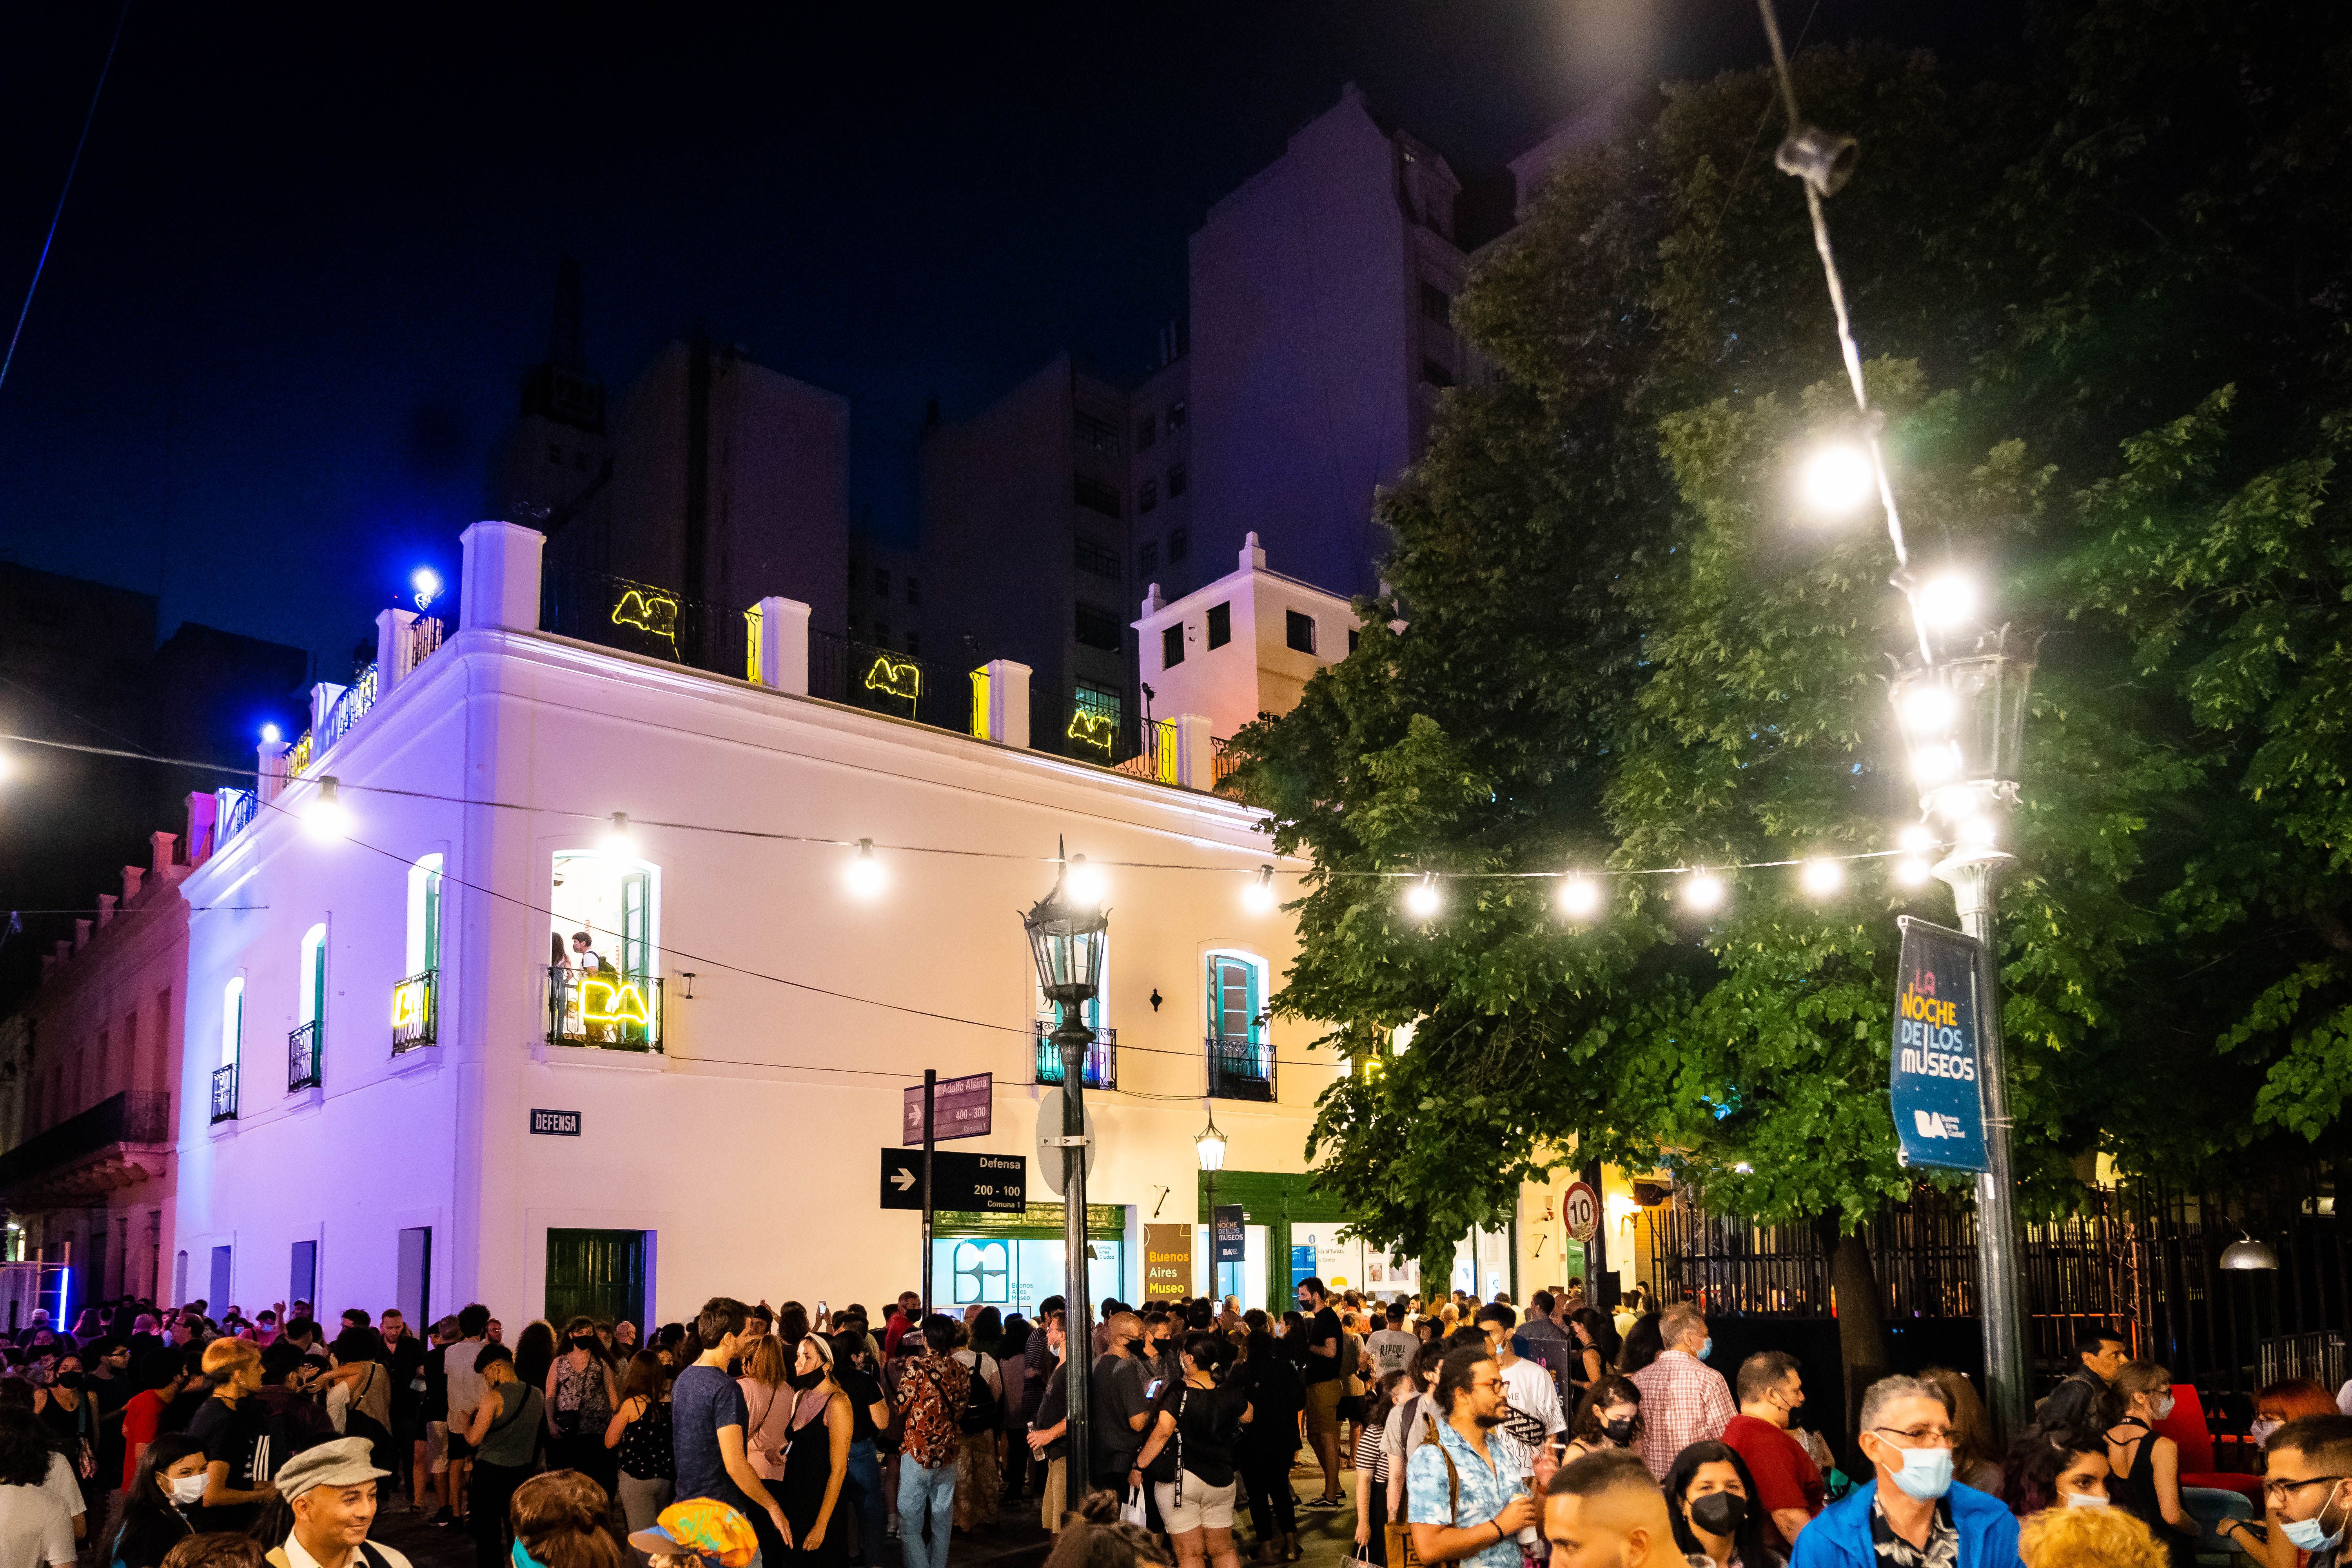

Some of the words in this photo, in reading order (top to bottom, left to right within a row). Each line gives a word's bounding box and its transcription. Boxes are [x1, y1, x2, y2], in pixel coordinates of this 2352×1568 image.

[1915, 969, 1935, 996] LA
[1901, 982, 1957, 1029] NOCHE
[1901, 1019, 1922, 1047] DE
[1929, 1025, 1963, 1052] LOS
[1901, 1024, 1975, 1081] MUSEOS
[942, 1082, 964, 1094] Adolfo
[965, 1078, 987, 1090] Alsina
[955, 1109, 968, 1120] 400
[973, 1106, 986, 1118] 300
[535, 1113, 576, 1132] DEFENSA
[980, 1157, 1020, 1169] Defensa
[974, 1185, 993, 1195] 200
[1004, 1186, 1020, 1196] 100
[1570, 1199, 1590, 1225] 10
[1217, 1220, 1238, 1229] NOCHE
[1219, 1229, 1243, 1241] MUSEOS
[1149, 1251, 1189, 1262] Buenos
[1149, 1267, 1177, 1278] Aires
[1149, 1283, 1185, 1294] Museo
